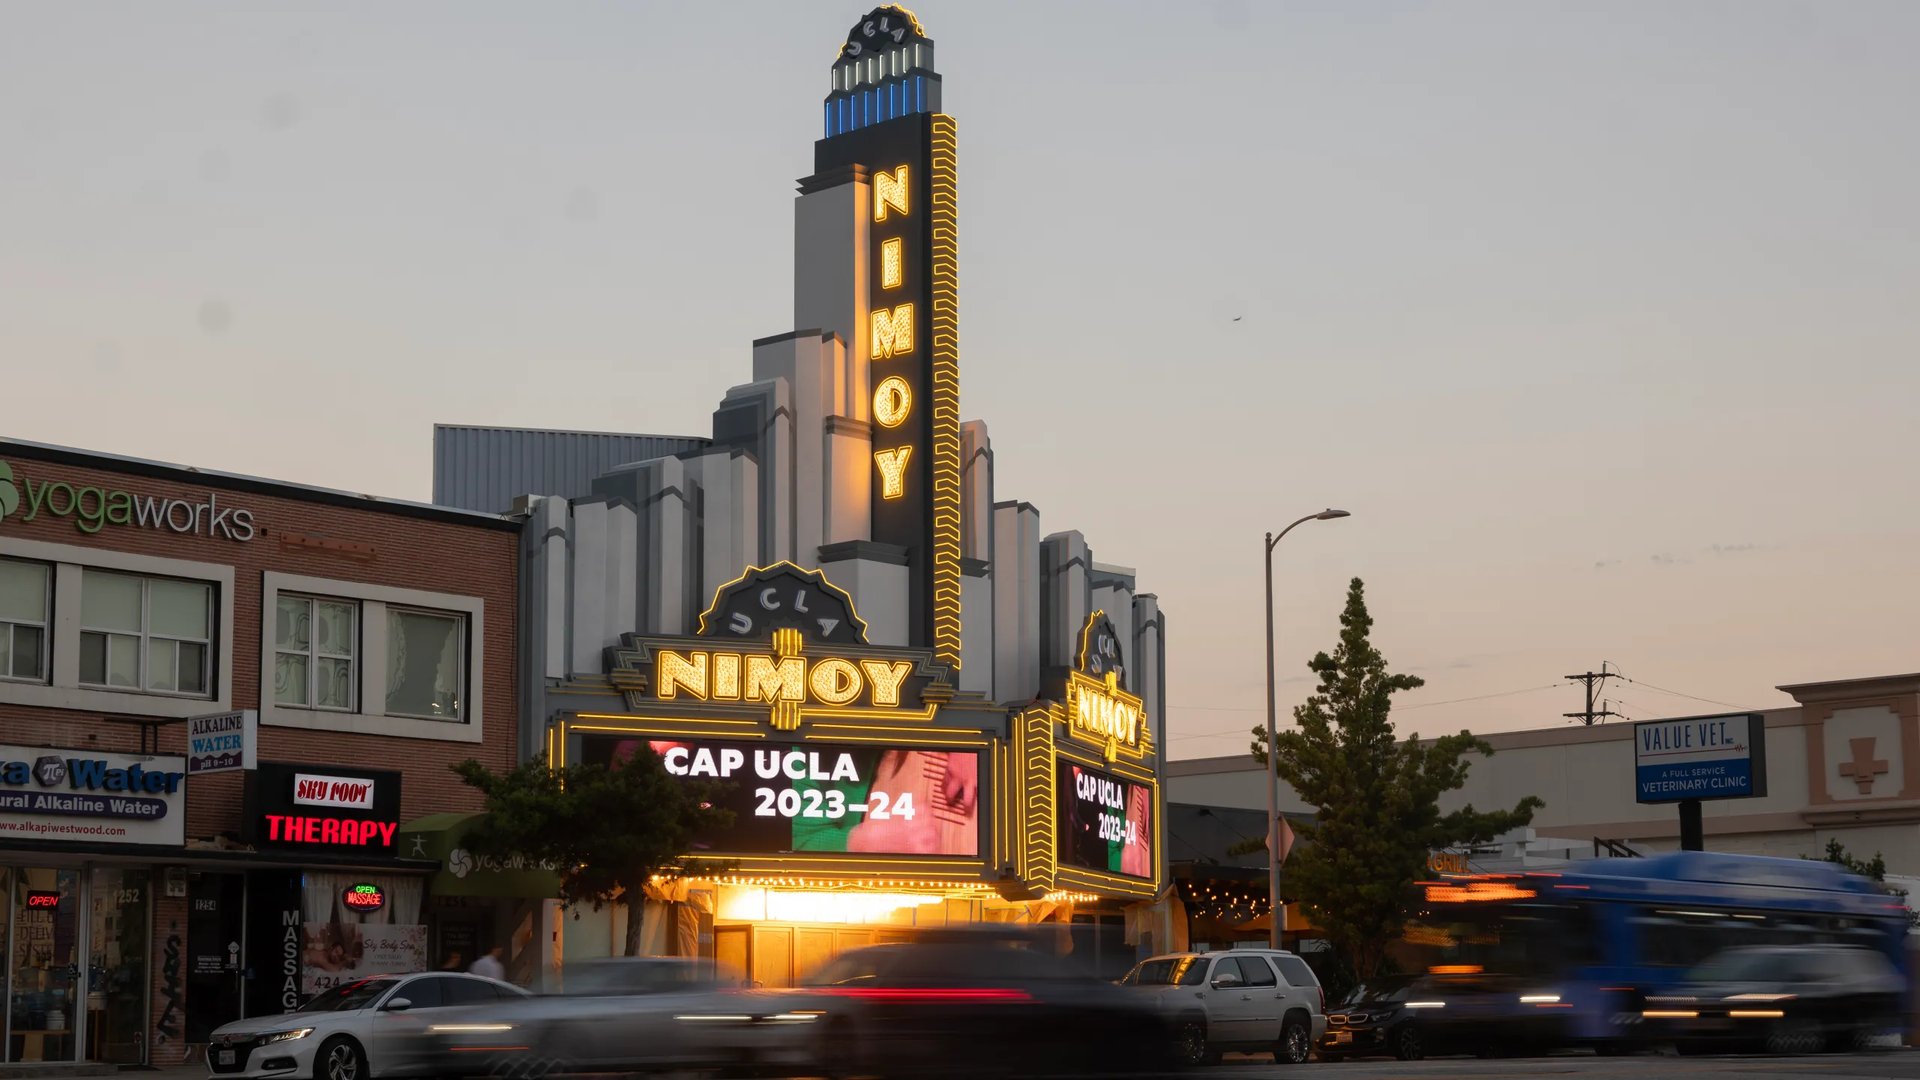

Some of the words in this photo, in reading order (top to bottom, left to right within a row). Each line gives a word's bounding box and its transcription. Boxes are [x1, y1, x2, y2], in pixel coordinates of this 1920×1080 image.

[847, 17, 905, 56] UCLA
[870, 165, 914, 500] NIMOY
[23, 478, 254, 541] yogaworks
[729, 588, 838, 637] UCLA
[657, 650, 913, 706] NIMOY
[192, 716, 242, 735] ALKALINE
[1075, 684, 1139, 747] NIMOY
[192, 735, 241, 753] WATER
[1643, 724, 1691, 751] VALUE
[1699, 722, 1726, 747] VET
[67, 759, 184, 793] Water
[201, 760, 211, 770] pH
[663, 747, 745, 777] CAP
[754, 750, 860, 782] UCLA
[1670, 769, 1690, 777] FULL
[1692, 766, 1725, 776] SERVICE
[1076, 772, 1096, 803] CAP
[1098, 780, 1123, 811] UCLA
[1642, 779, 1708, 793] VETERINARY
[1711, 775, 1747, 788] CLINIC
[34, 797, 104, 812] Alkaline
[110, 799, 159, 815] Water
[264, 815, 397, 847] THERAPY
[29, 895, 59, 907] OPEN
[347, 892, 381, 905] MASSAGE
[355, 885, 376, 894] OPEN
[282, 910, 300, 1014] MASSAG
